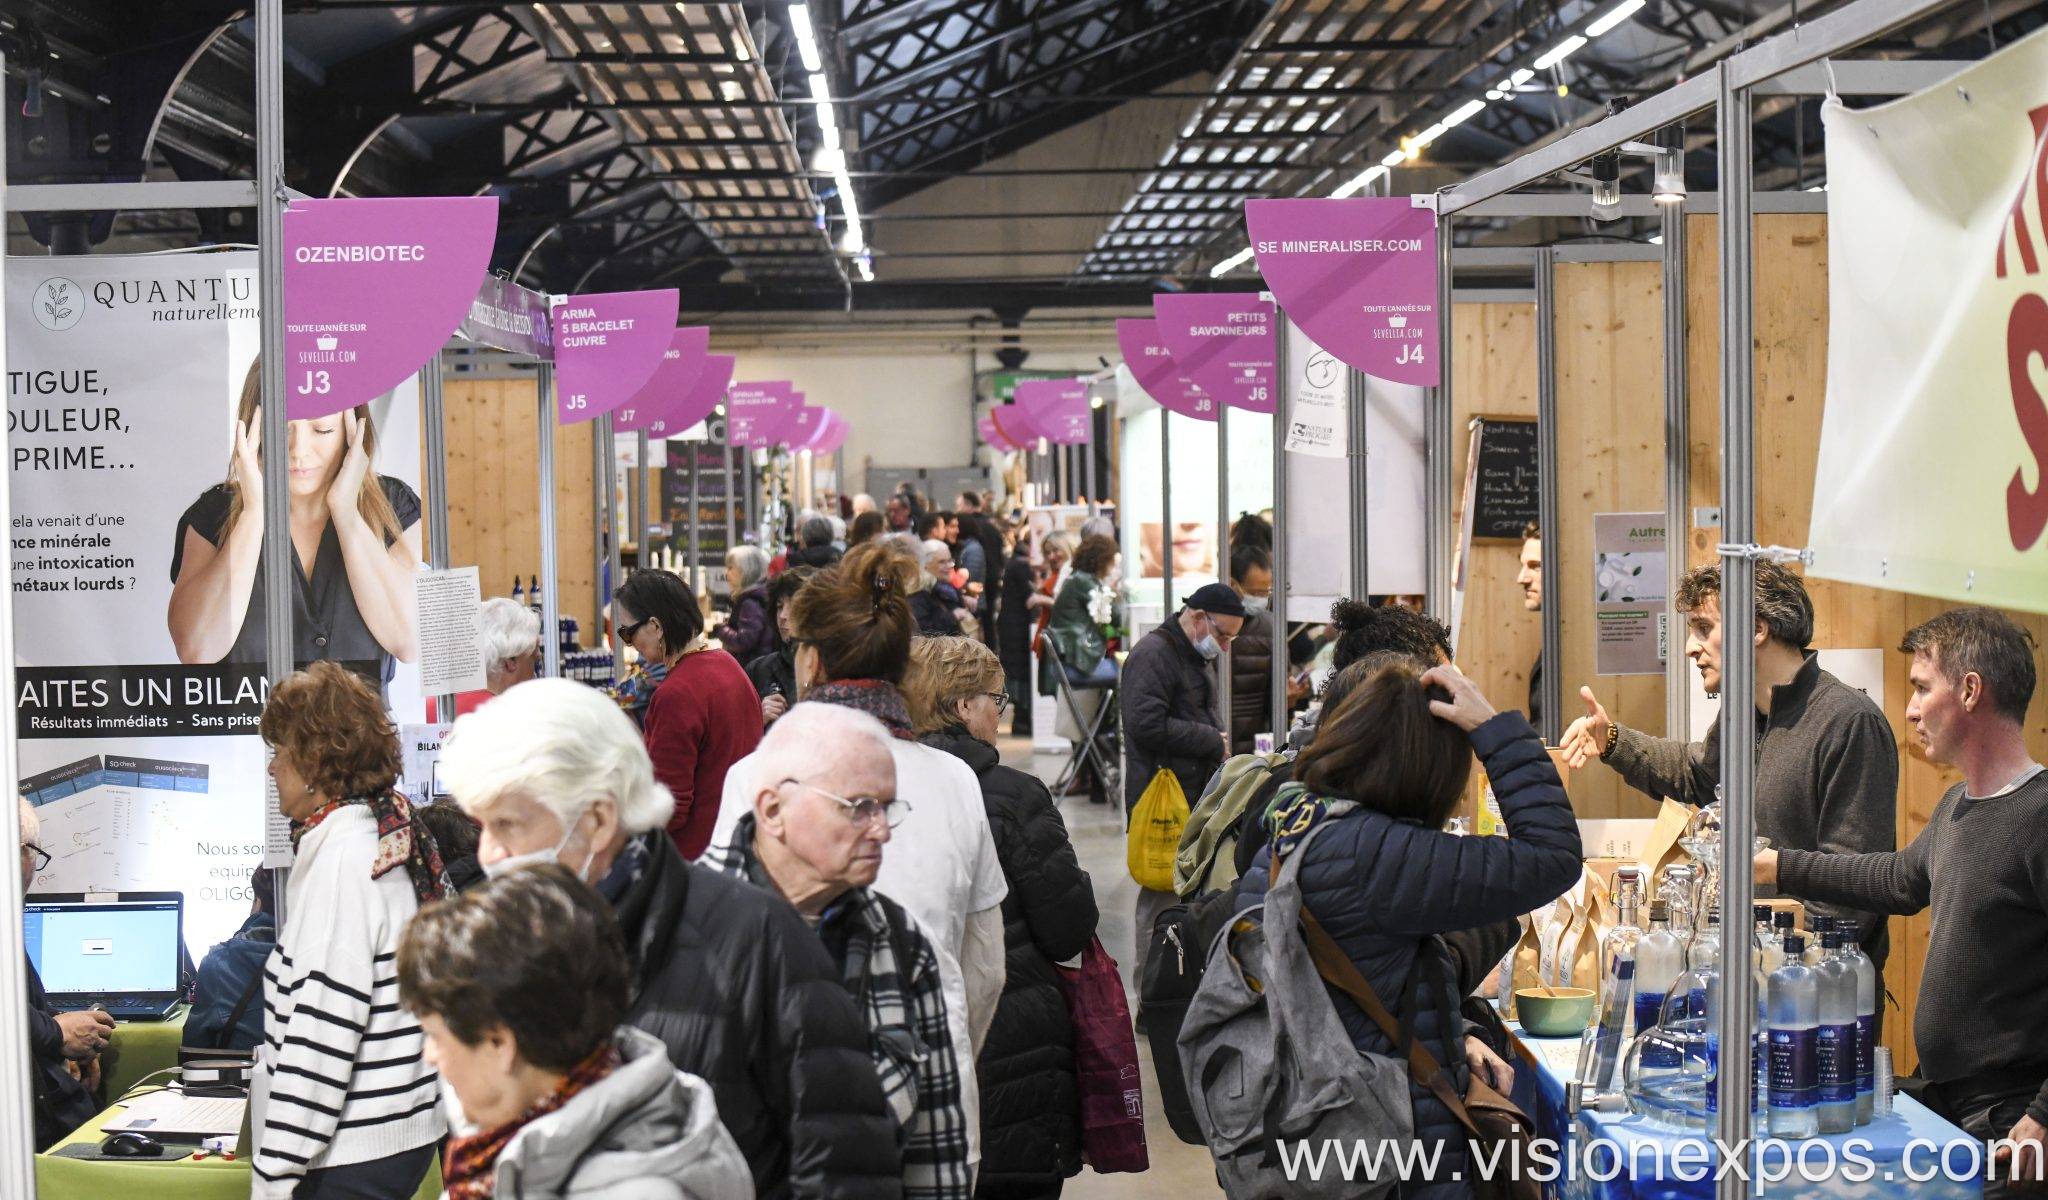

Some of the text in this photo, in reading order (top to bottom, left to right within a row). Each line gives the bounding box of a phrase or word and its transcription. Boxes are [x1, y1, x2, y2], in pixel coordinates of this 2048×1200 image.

[1258, 239, 1422, 253] SE MINERALISER.COM
[295, 245, 425, 263] OZENBIOTEC
[93, 276, 251, 308] QUANTU
[561, 308, 596, 319] ARMA
[1363, 303, 1432, 313] TOUTE L'ANNÉE SUR
[1228, 312, 1267, 322] PETITS
[287, 321, 367, 332] TOUTE L'ANNÉE SUR
[562, 319, 635, 333] 5 BRACELET
[1190, 326, 1267, 336] SAVONNEURS
[1372, 328, 1423, 339] SEVELLIA.COM
[562, 335, 607, 347] CUIVRE
[299, 351, 356, 363] SEVELLIA.COM
[1145, 346, 1159, 355] DE
[1395, 344, 1425, 365] J4
[297, 370, 331, 394] J3
[1248, 387, 1268, 401] J6
[567, 395, 587, 410] J5
[1194, 399, 1212, 411] J8
[620, 410, 636, 422] J7
[650, 421, 665, 432] J9
[37, 514, 81, 527] venait
[85, 513, 125, 526] d'une
[40, 533, 111, 548] minérale
[38, 555, 135, 570] intoxication
[74, 576, 125, 591] lourds
[18, 680, 109, 708] AITES
[122, 678, 172, 706] UN
[31, 715, 93, 729] Résultats
[96, 714, 169, 728] immédiats
[192, 714, 225, 727] Sans
[228, 713, 261, 730] prise
[197, 842, 238, 856] Nous
